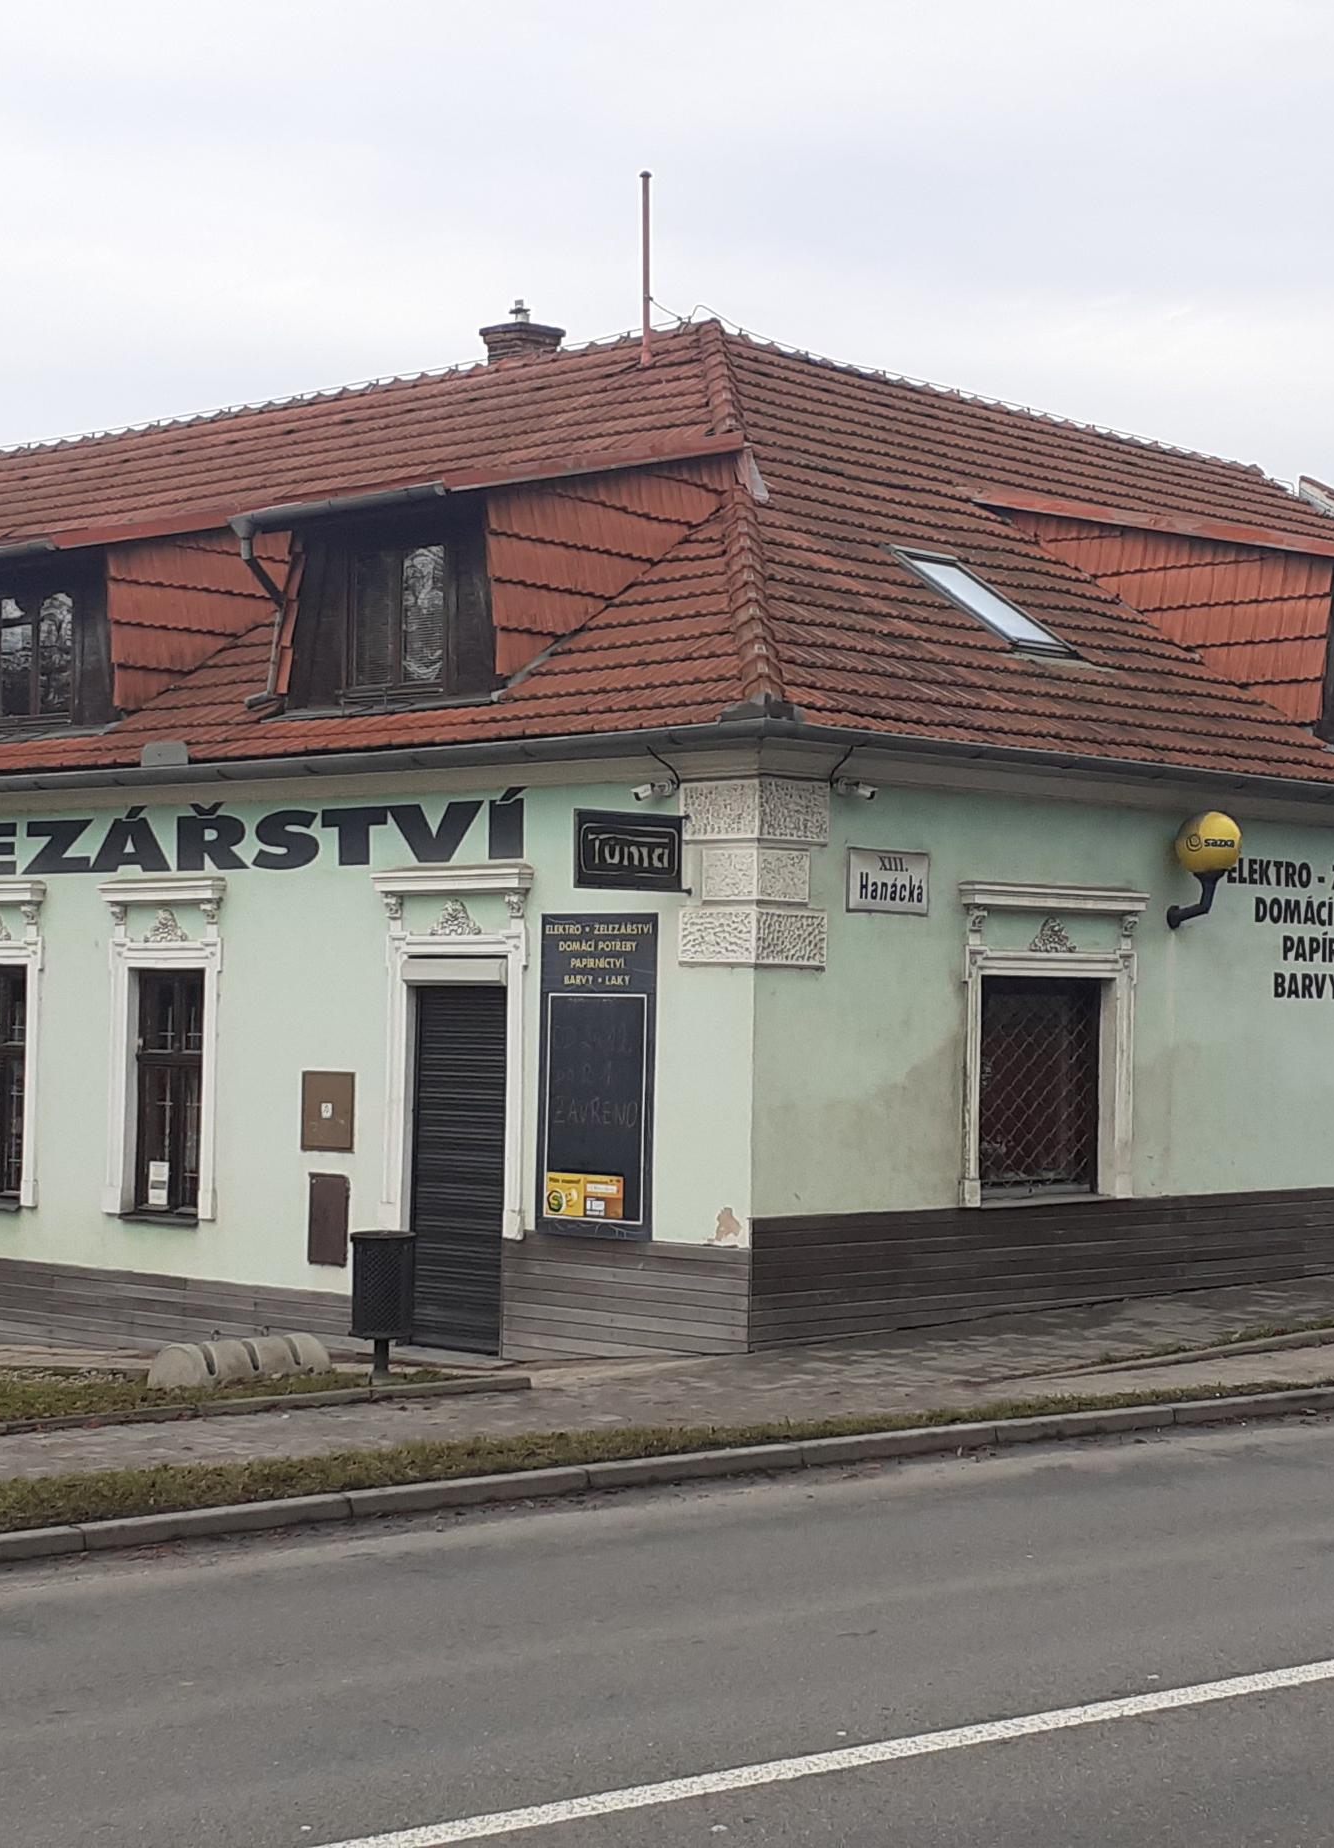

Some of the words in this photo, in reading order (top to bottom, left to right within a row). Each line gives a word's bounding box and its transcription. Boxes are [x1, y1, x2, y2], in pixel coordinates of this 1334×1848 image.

[878, 856, 909, 873] XIII.
[1227, 857, 1311, 888] ELEKTRO
[859, 872, 924, 903] Hanácká
[1254, 895, 1334, 926] DOMÁCÍ
[545, 924, 582, 935] ELEKTRO
[593, 922, 653, 935] ŽELEZÁŘSTVÍ
[558, 939, 595, 951] DOMÁCÍ
[598, 939, 637, 951] POTŘEBY
[563, 975, 593, 985] BARVY
[605, 975, 630, 985] LAKY
